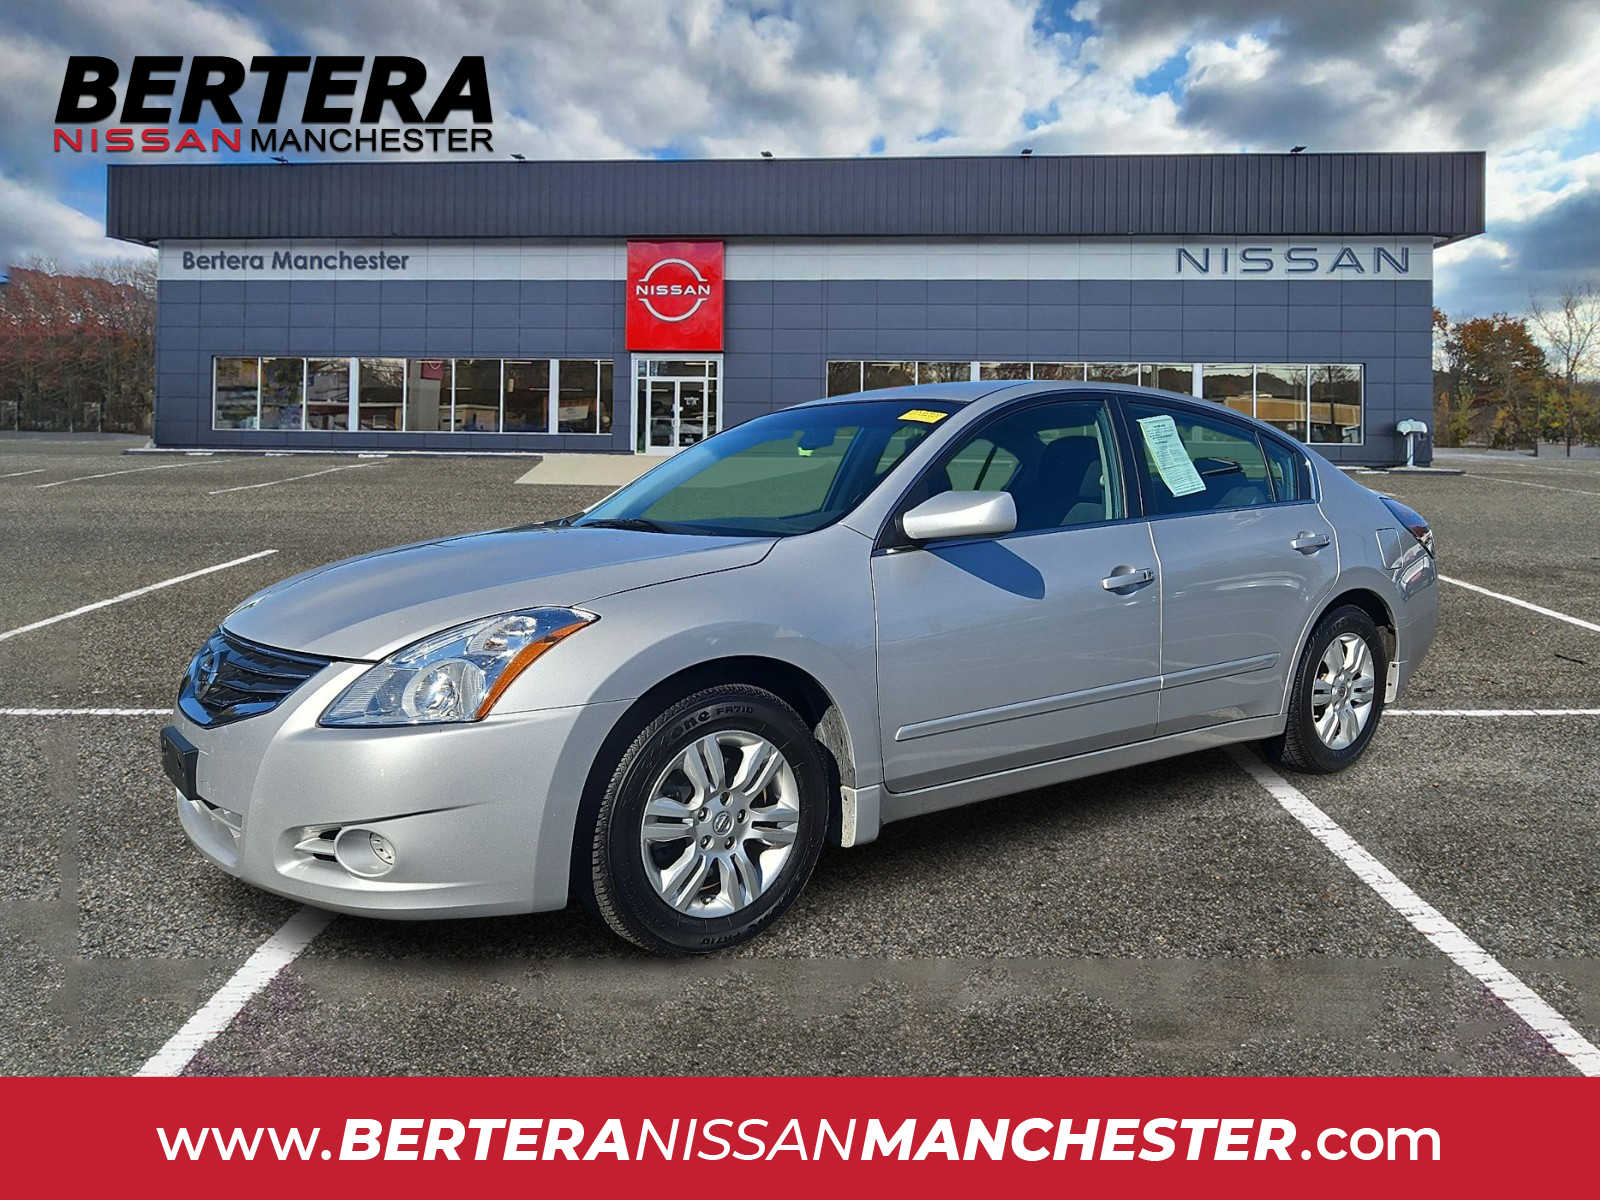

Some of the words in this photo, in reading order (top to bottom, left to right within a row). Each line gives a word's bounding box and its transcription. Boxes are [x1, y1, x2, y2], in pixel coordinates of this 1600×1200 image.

[182, 251, 264, 270] Bertera
[274, 251, 409, 270] Manchester
[1177, 248, 1409, 273] NISSAN
[636, 285, 710, 295] NISSAN
